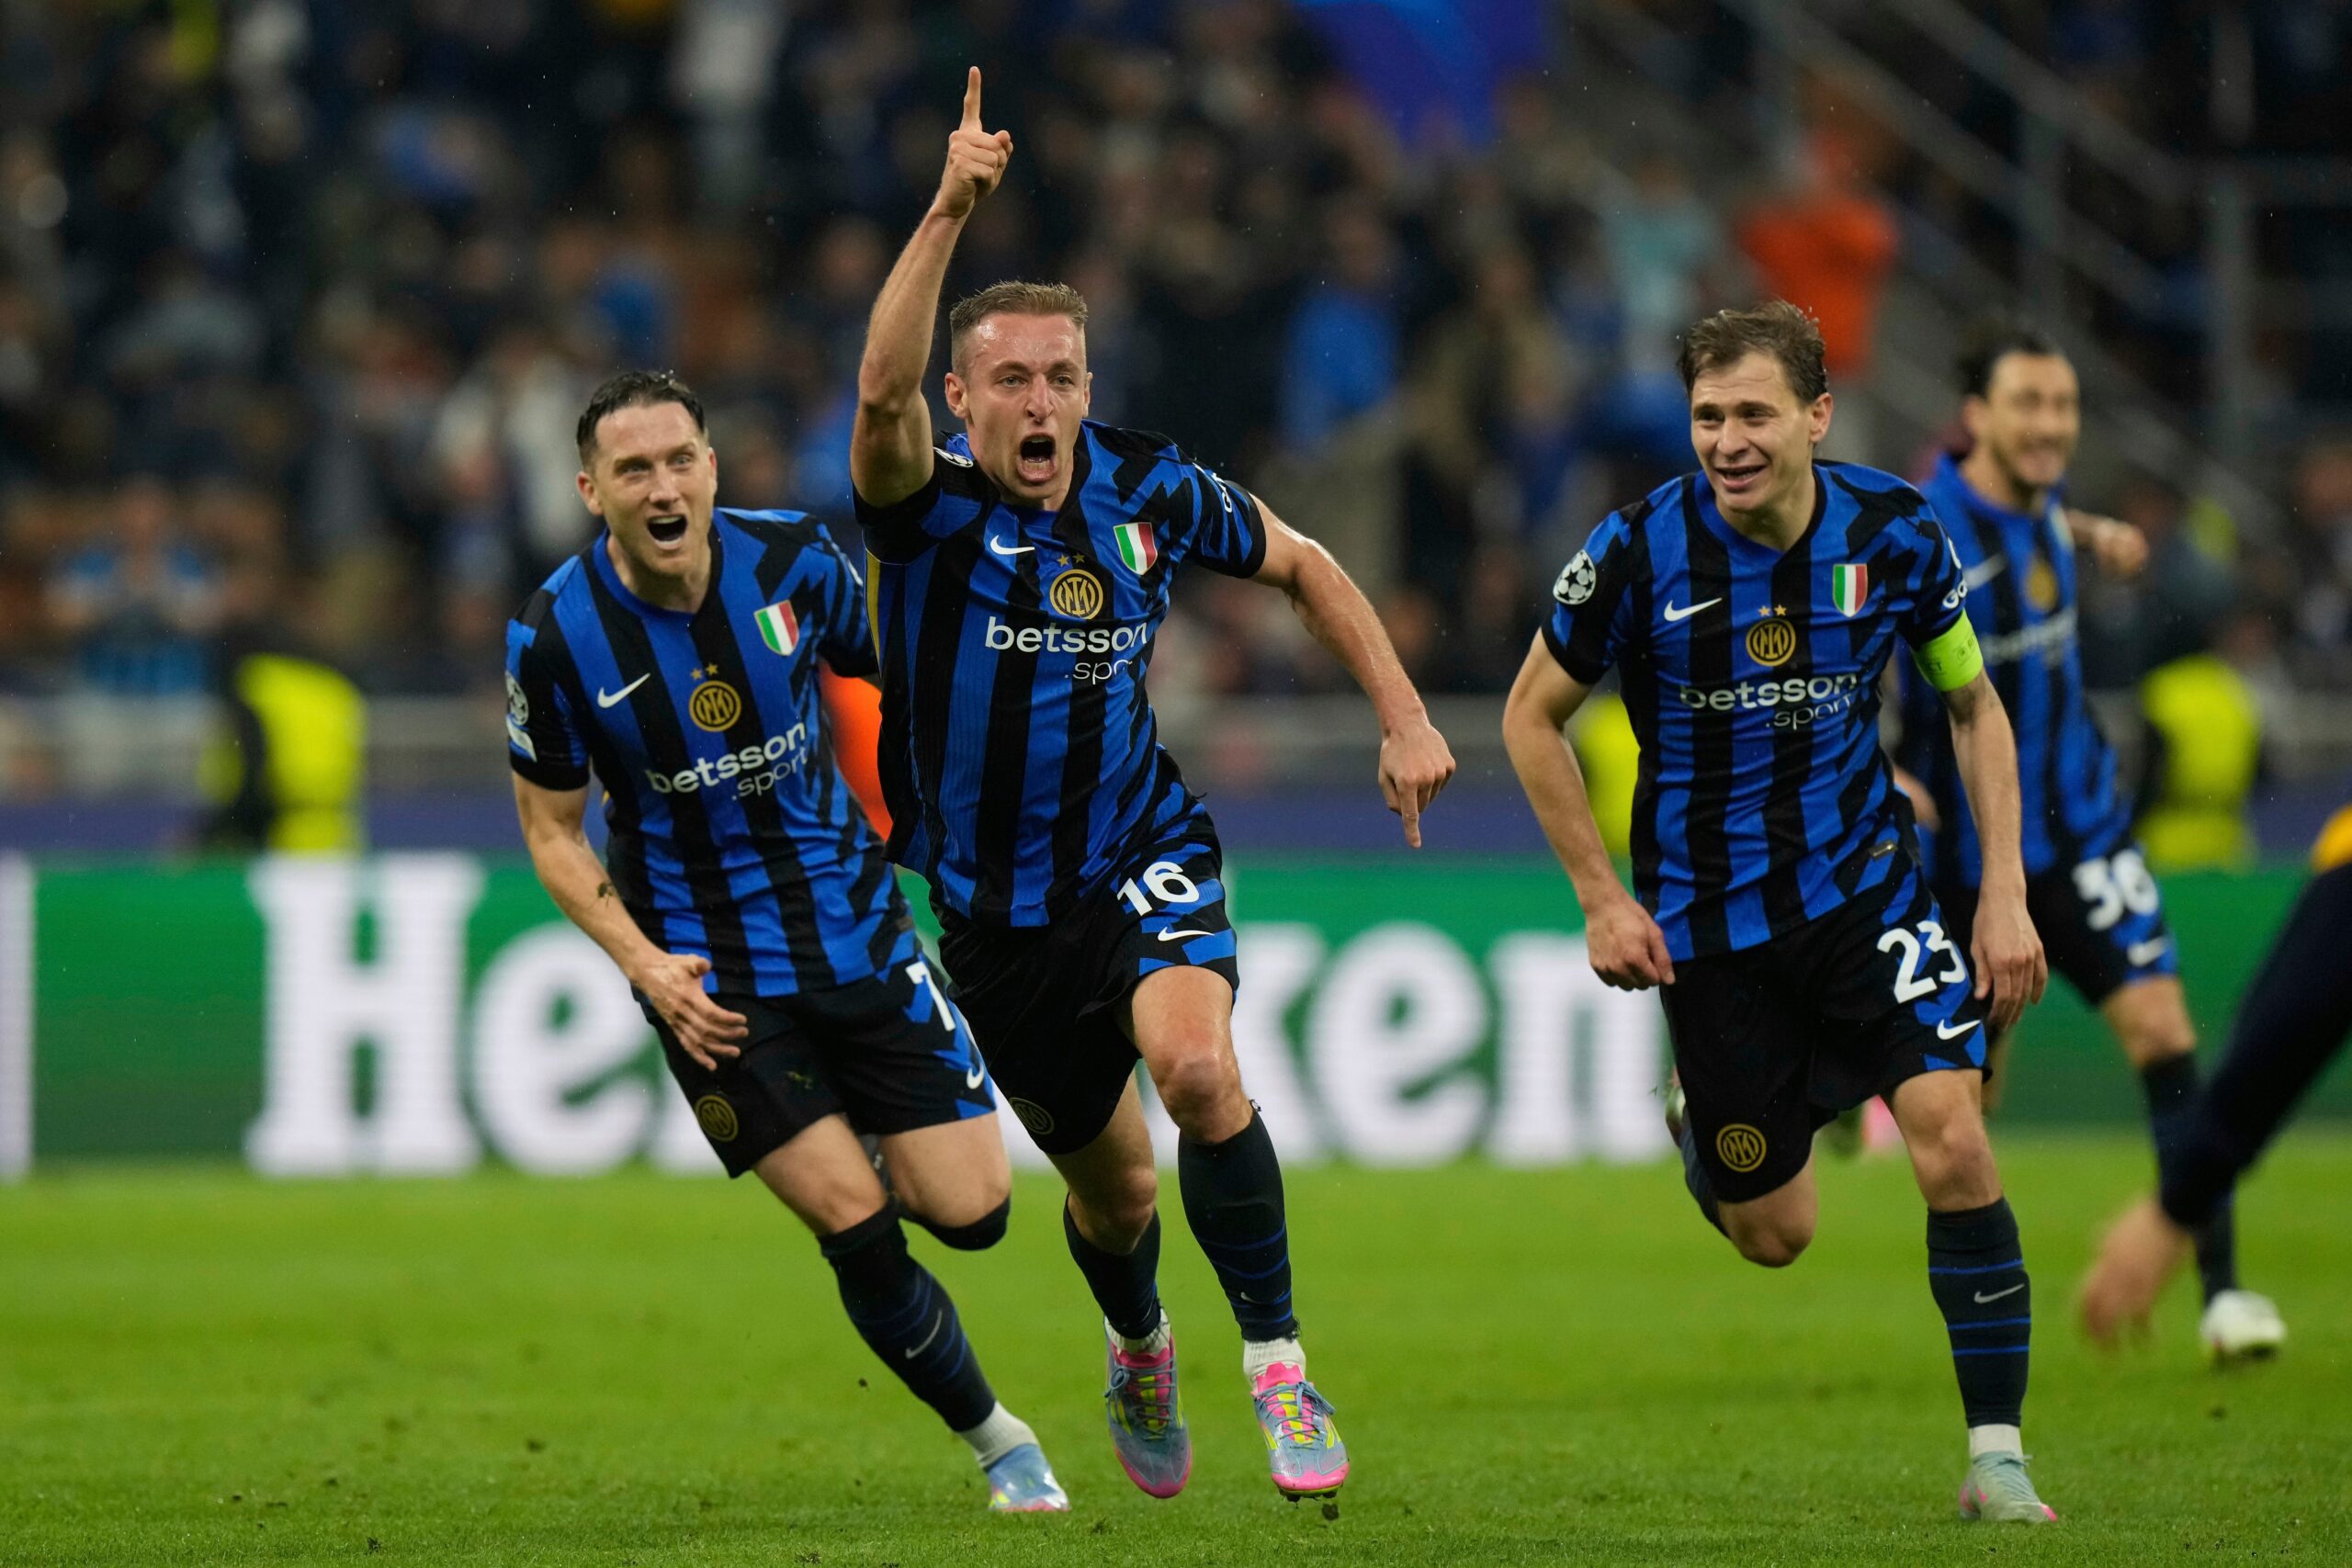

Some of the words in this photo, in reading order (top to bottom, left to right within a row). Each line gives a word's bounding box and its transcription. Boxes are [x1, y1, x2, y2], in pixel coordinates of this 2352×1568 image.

[985, 616, 1148, 653] betsson
[1679, 673, 1857, 711] betsson
[646, 722, 806, 794] betsson
[1116, 861, 1200, 917] 16
[1876, 919, 1966, 1004] 23
[906, 961, 956, 1032] 7
